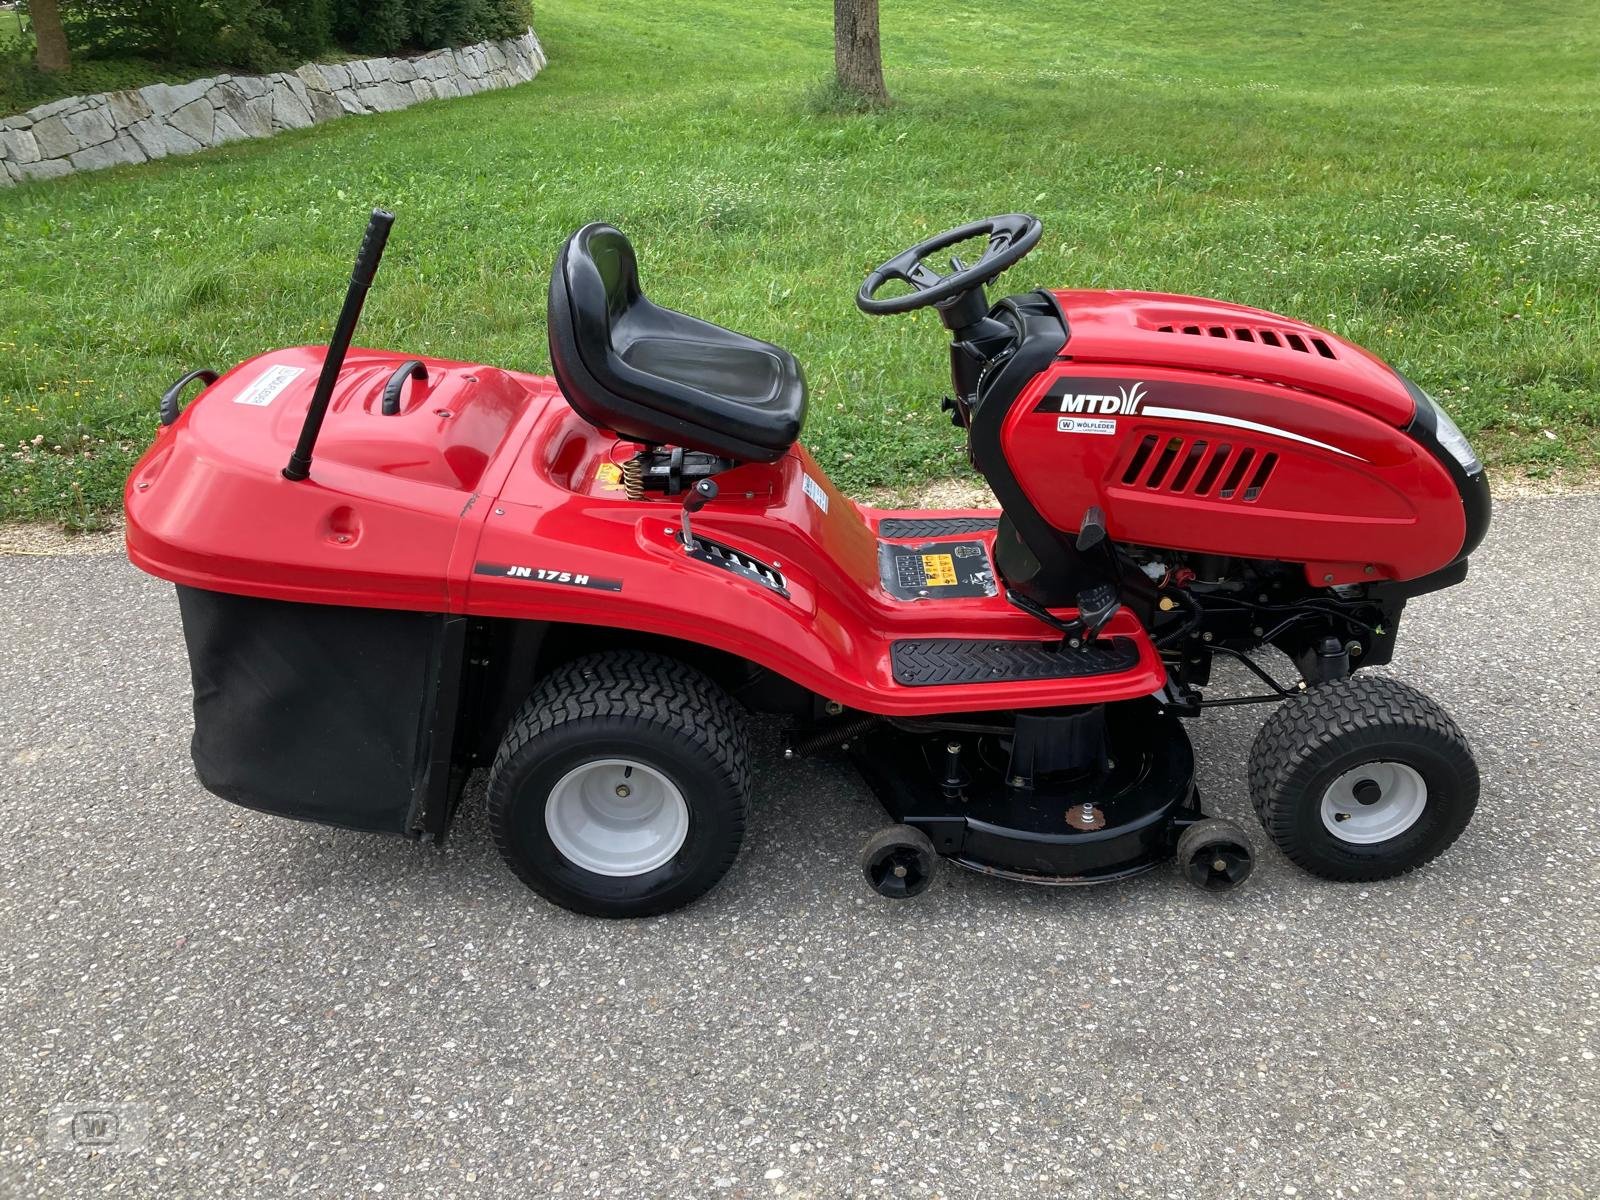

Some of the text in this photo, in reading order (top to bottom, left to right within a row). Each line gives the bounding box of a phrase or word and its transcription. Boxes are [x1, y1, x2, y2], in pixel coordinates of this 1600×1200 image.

[1060, 393, 1121, 414] MTD
[1076, 421, 1115, 430] WÖLFLEDER
[507, 565, 589, 585] JN 175 H
